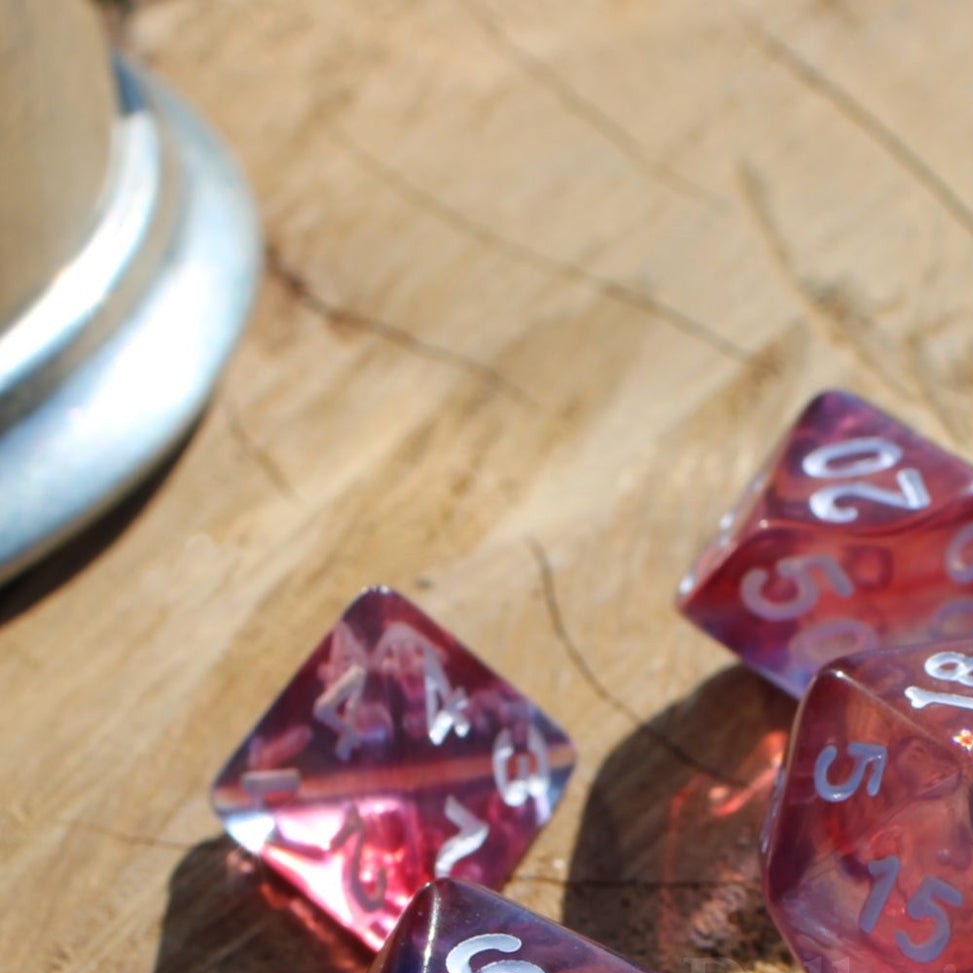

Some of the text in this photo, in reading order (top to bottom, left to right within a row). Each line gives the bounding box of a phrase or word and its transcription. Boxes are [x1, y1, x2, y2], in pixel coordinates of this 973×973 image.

[802, 437, 931, 523] 20
[814, 742, 888, 803] 5
[858, 856, 963, 963] 15
